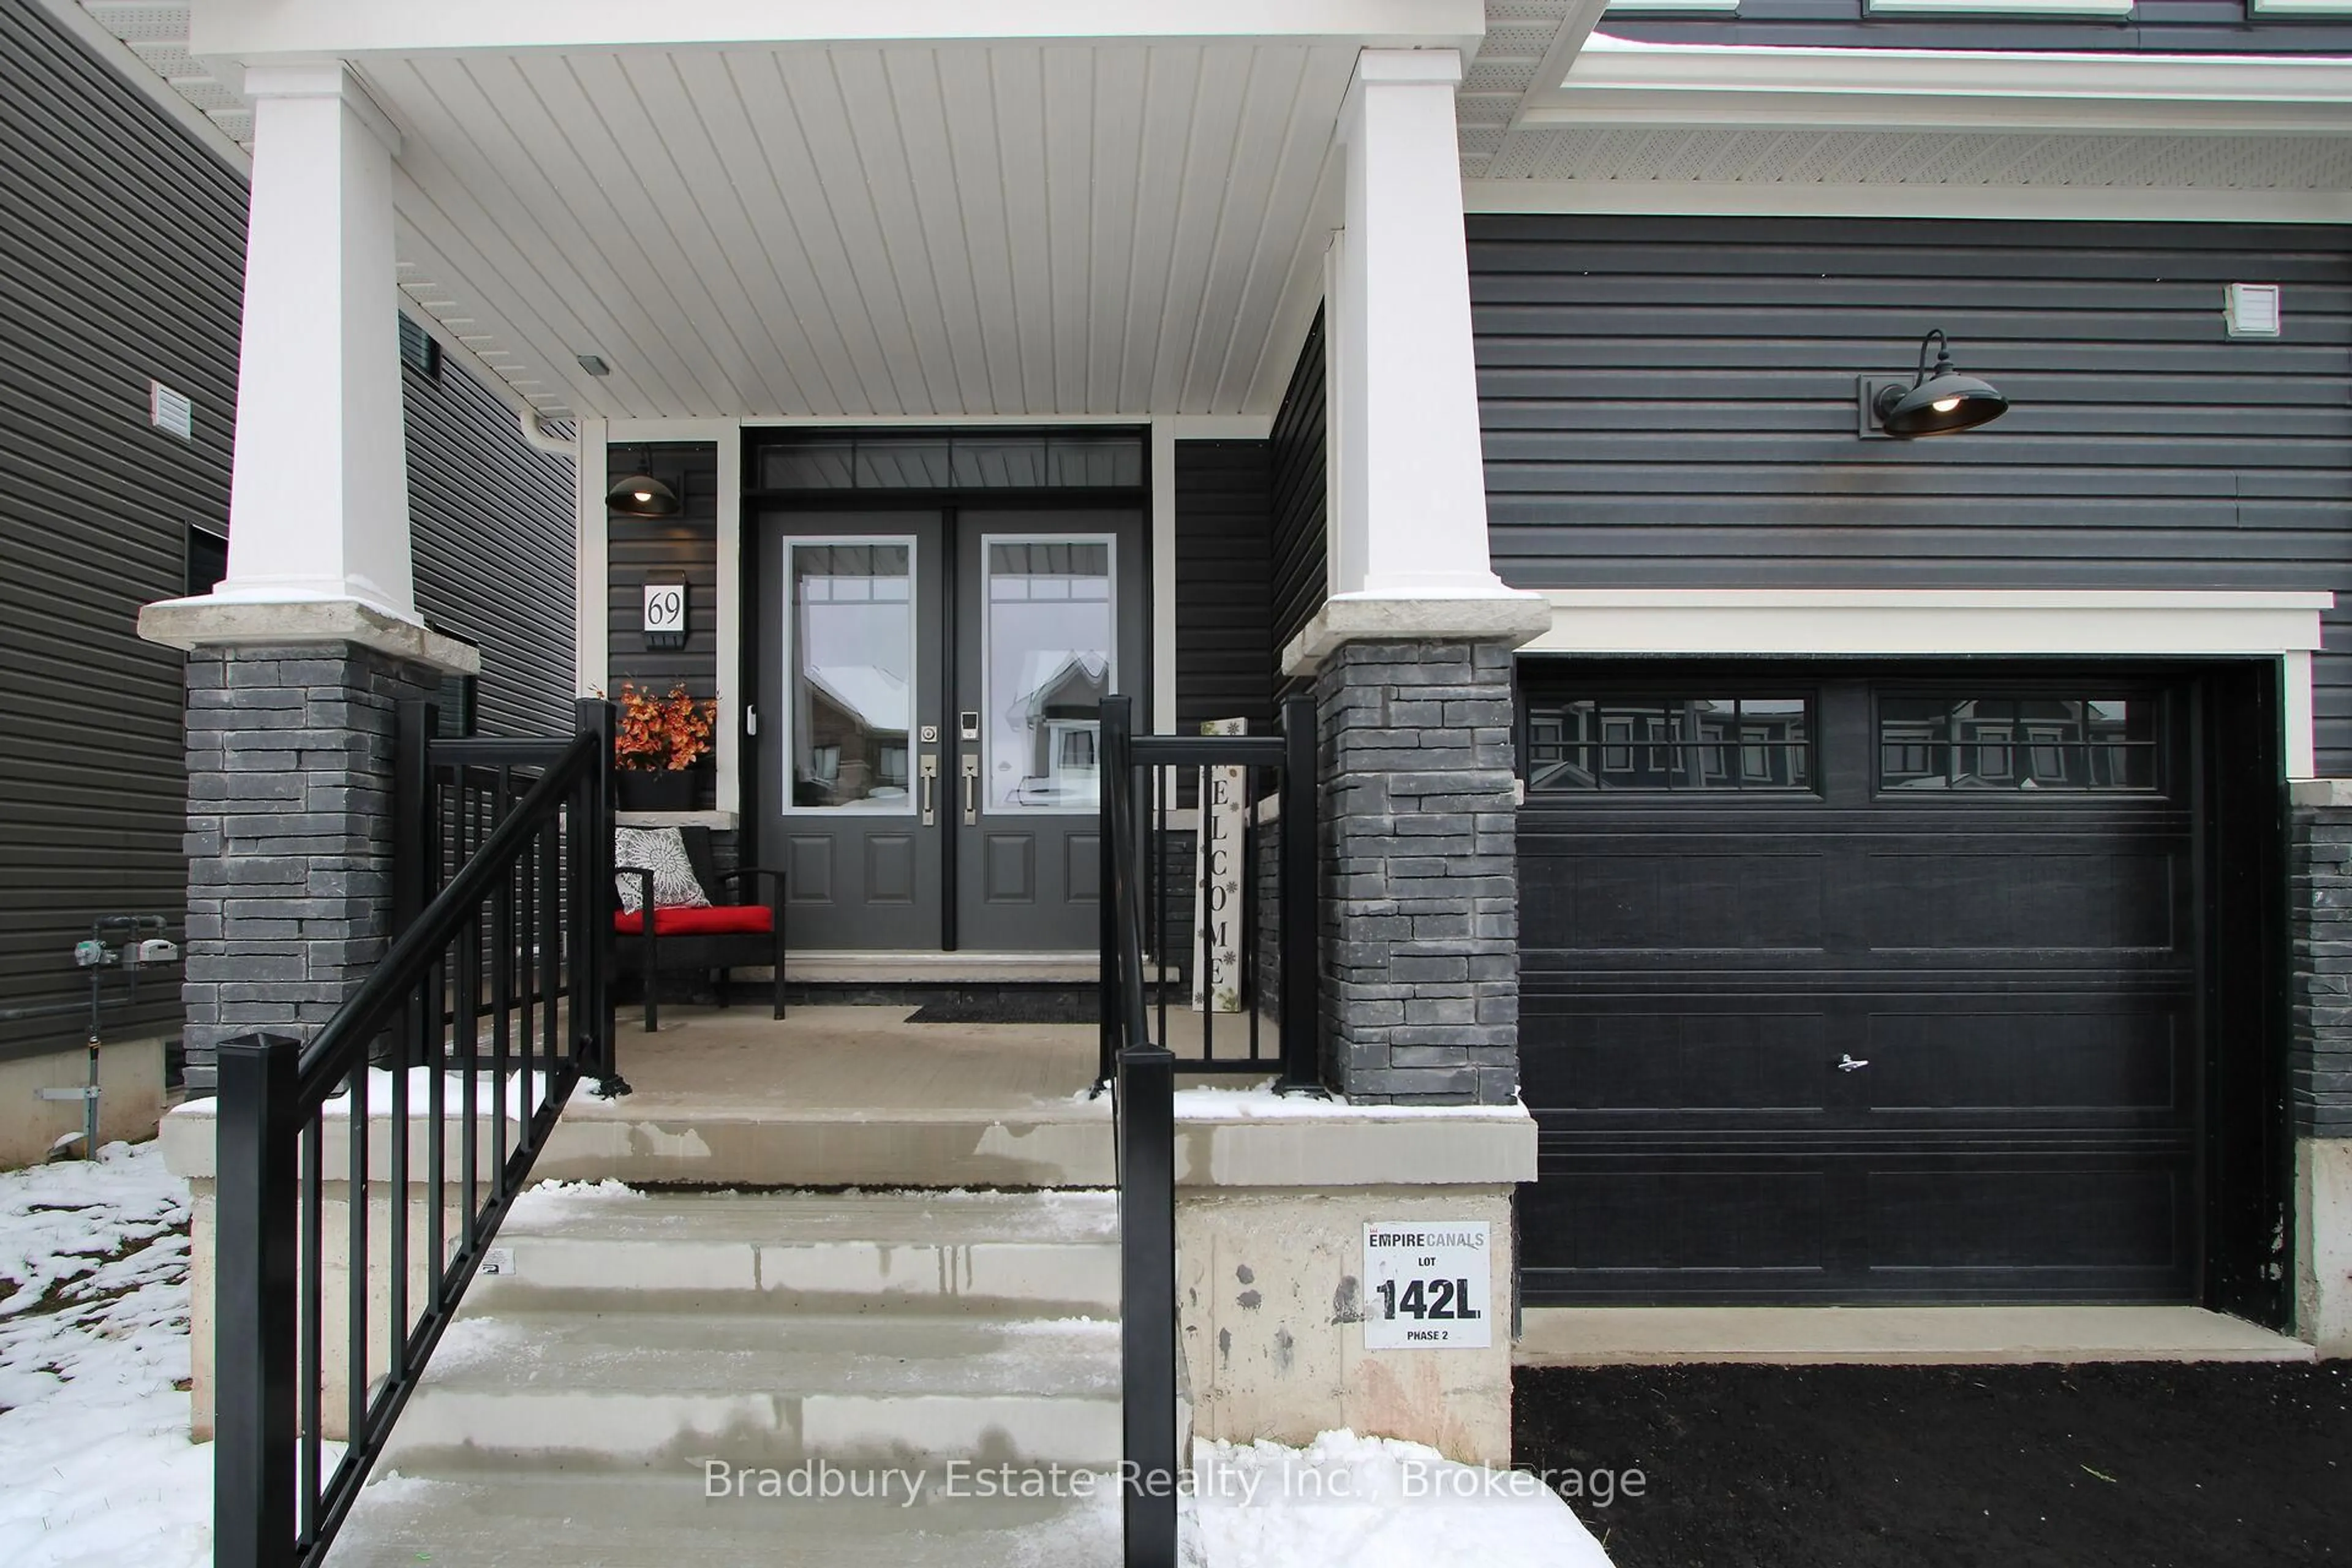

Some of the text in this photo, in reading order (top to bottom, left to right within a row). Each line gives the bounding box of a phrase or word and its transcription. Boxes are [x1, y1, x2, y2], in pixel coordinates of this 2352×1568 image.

[648, 591, 680, 625] 69
[1209, 764, 1229, 985] ELCOME
[1418, 1257, 1436, 1267] LOT
[1407, 1331, 1449, 1340] PHASE 2
